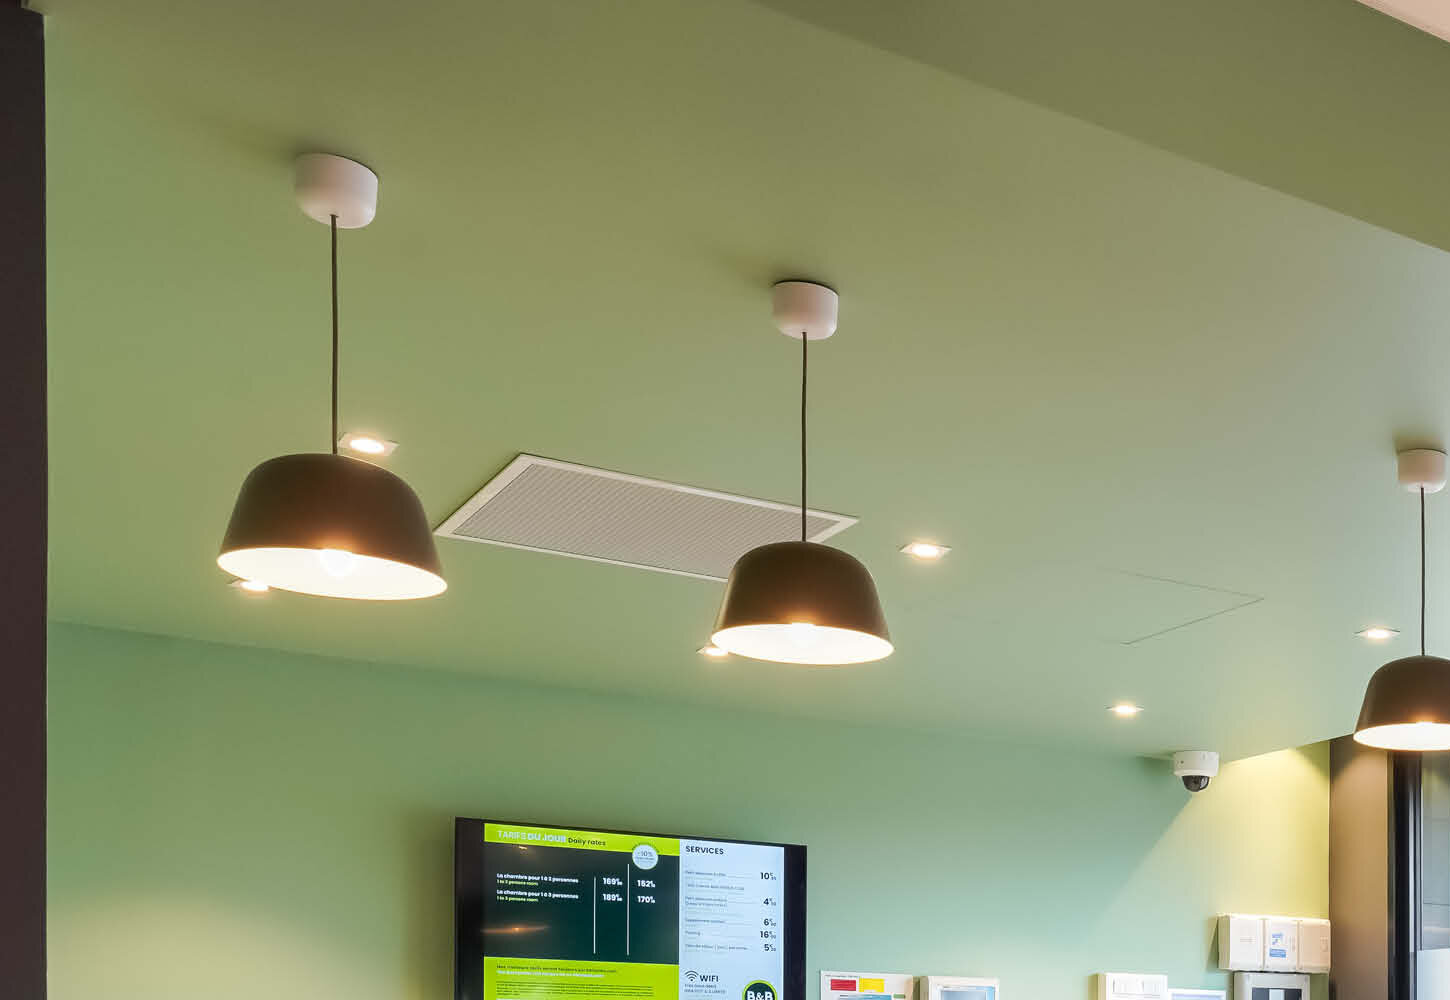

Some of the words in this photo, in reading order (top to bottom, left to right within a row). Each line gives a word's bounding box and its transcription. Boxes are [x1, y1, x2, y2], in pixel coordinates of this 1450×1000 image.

[527, 832, 541, 841] DU
[542, 833, 567, 843] JOUR
[567, 837, 586, 846] Daily
[587, 839, 606, 847] rates
[685, 845, 724, 855] SERVICES
[699, 975, 719, 983] WIFI
